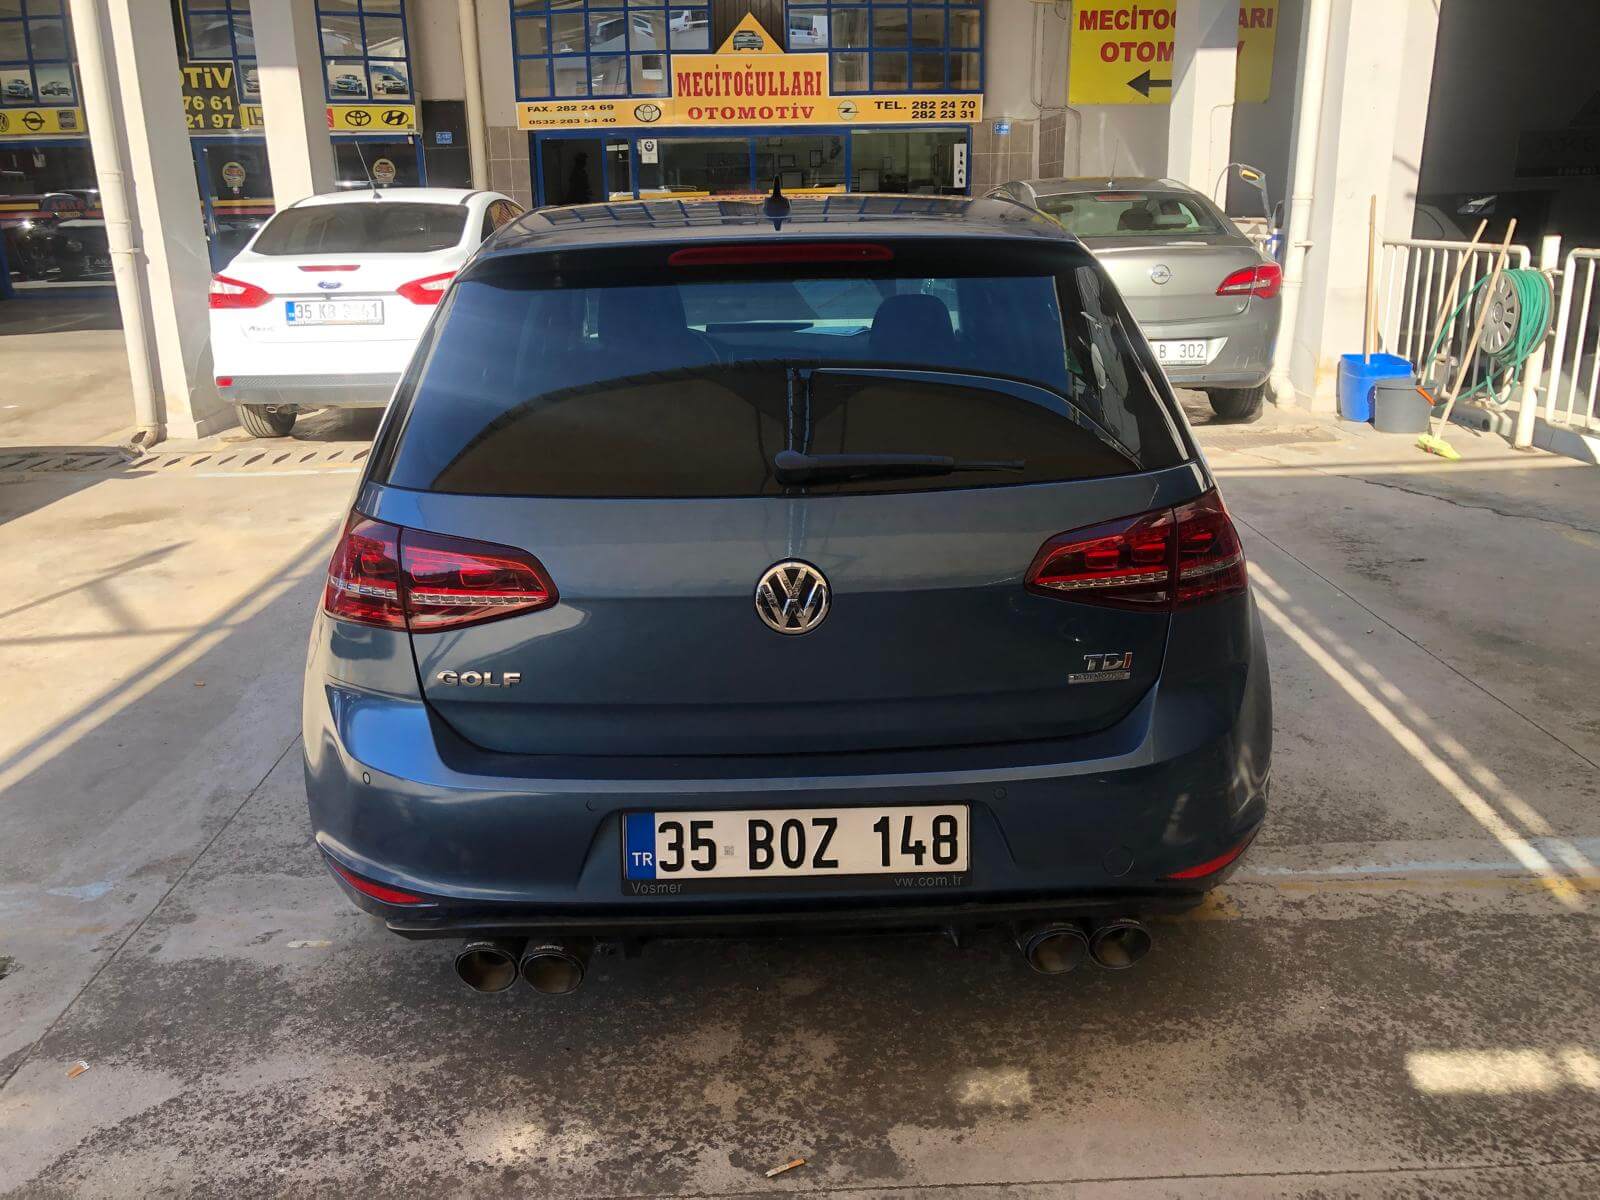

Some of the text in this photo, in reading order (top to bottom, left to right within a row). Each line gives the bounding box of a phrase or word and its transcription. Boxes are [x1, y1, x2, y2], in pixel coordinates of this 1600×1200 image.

[1079, 5, 1274, 31] MECİTOARI
[677, 64, 822, 97] MECİTOĞULLARI
[210, 95, 232, 111] 61
[687, 102, 815, 120] OTOMOTİV
[874, 101, 976, 110] TEL. 282 24 70
[211, 114, 235, 128] 97
[912, 110, 974, 119] 282 23 31
[295, 304, 312, 319] 35
[1159, 343, 1204, 359] B 302
[1083, 652, 1133, 671] TDI
[436, 670, 521, 688] GOLF
[631, 814, 959, 872] TR 35 BOZ 148
[894, 872, 964, 887] vw.com.tr
[631, 881, 682, 895] Vosmer
